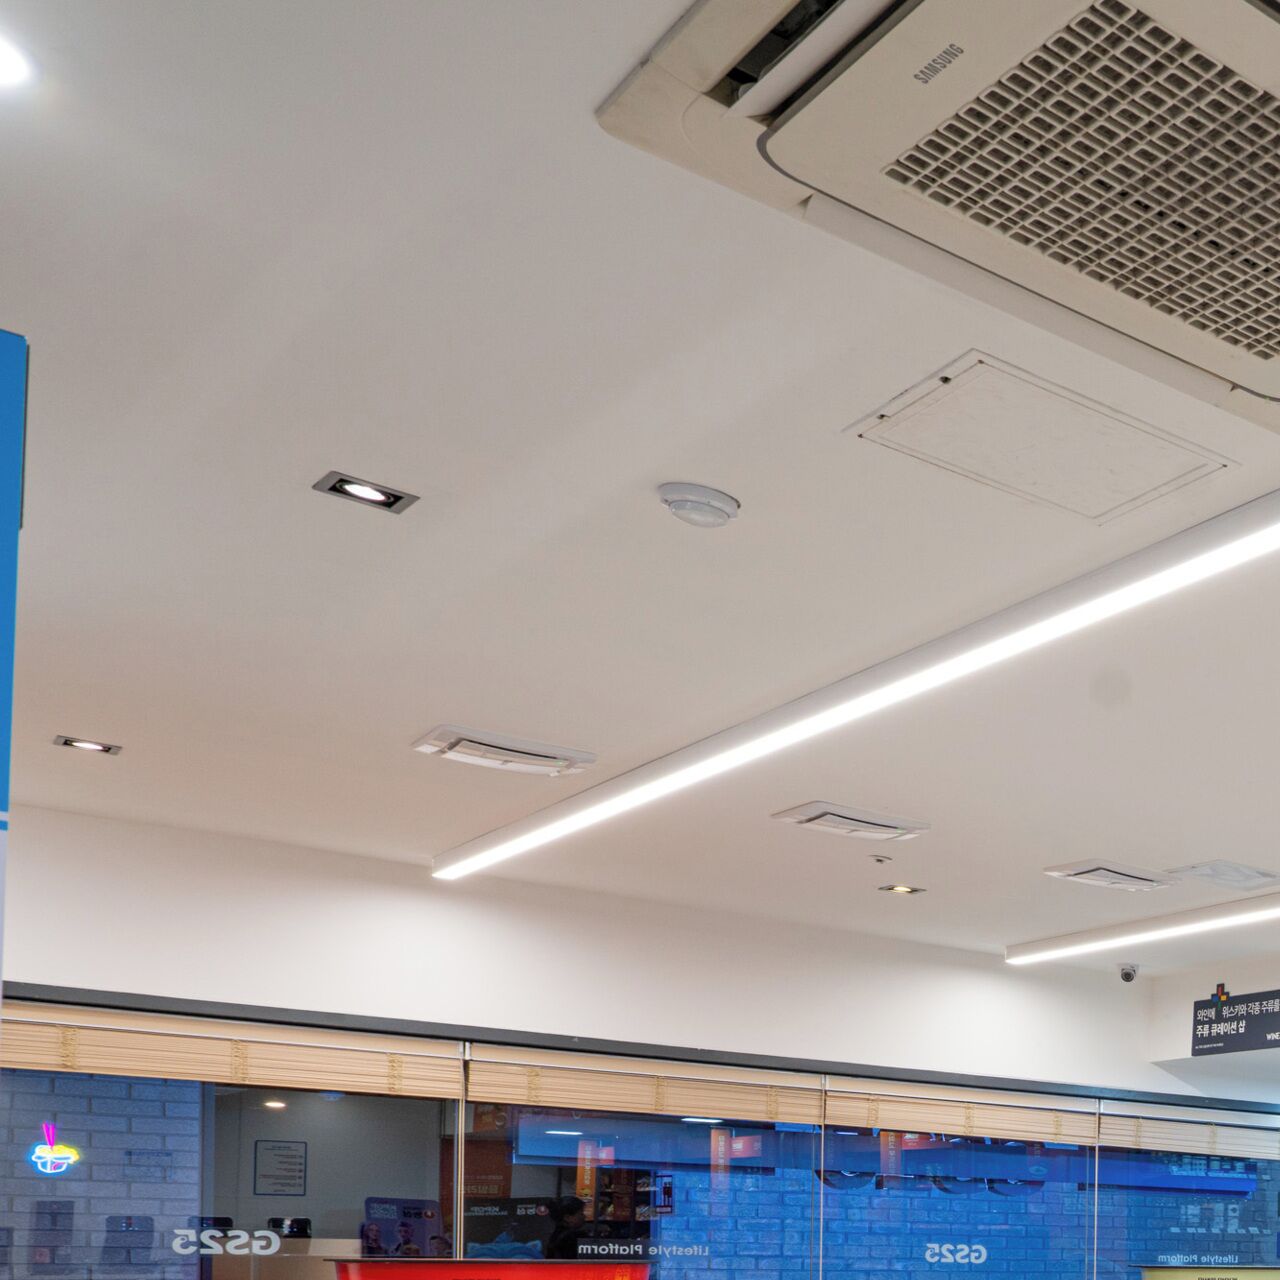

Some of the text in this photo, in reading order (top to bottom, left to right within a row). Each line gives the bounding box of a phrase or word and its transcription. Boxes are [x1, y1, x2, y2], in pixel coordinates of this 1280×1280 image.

[914, 43, 964, 84] SAMSUNG
[1248, 1003, 1260, 1014] 각종
[1196, 1020, 1245, 1037] 주류 큐레이션 샵
